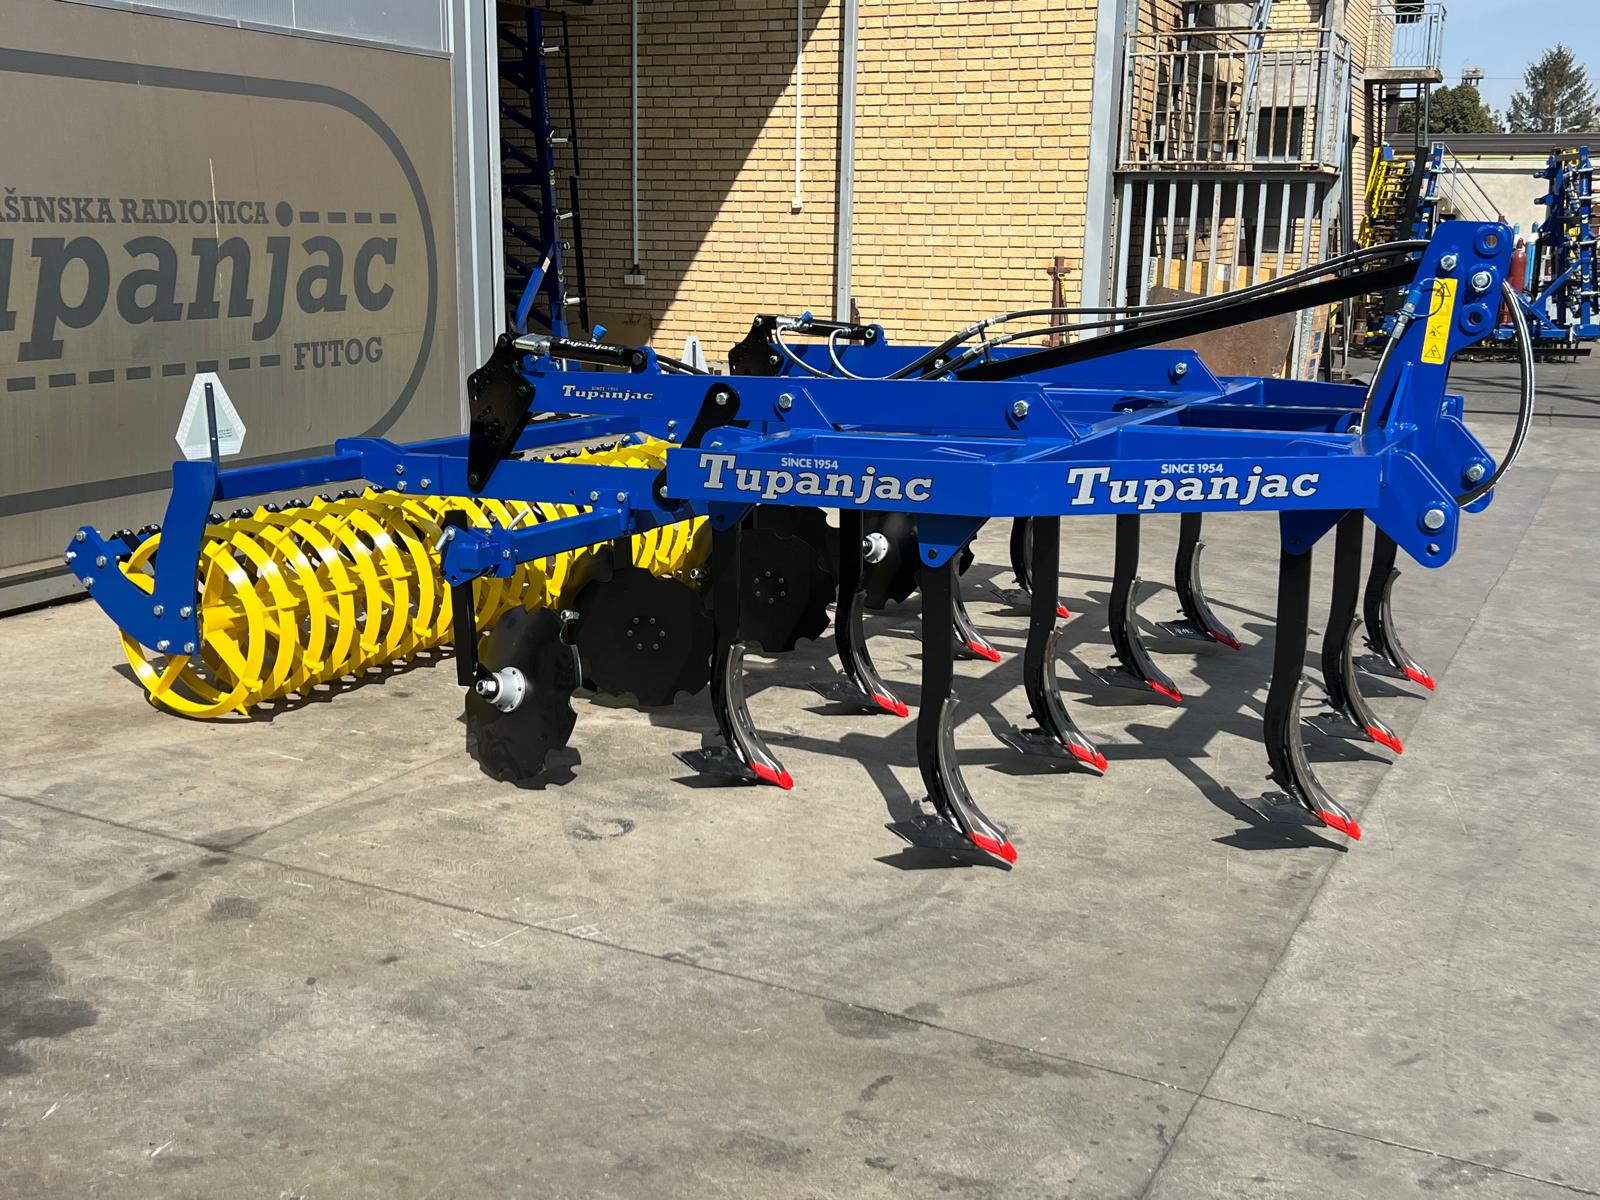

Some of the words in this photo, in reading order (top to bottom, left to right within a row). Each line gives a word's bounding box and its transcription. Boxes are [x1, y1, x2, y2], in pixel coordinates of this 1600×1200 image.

[121, 198, 269, 225] RADIONICA
[0, 201, 398, 362] panjac
[294, 336, 383, 370] FUTOG
[559, 338, 616, 351] Tupanjac
[562, 385, 654, 401] Tupanjac
[781, 457, 812, 469] SINCE
[813, 458, 839, 470] 1954
[1160, 464, 1195, 474] SINCE
[1197, 463, 1224, 474] 1954
[699, 453, 932, 504] Tupanjac
[1067, 466, 1320, 510] Tupanjac
